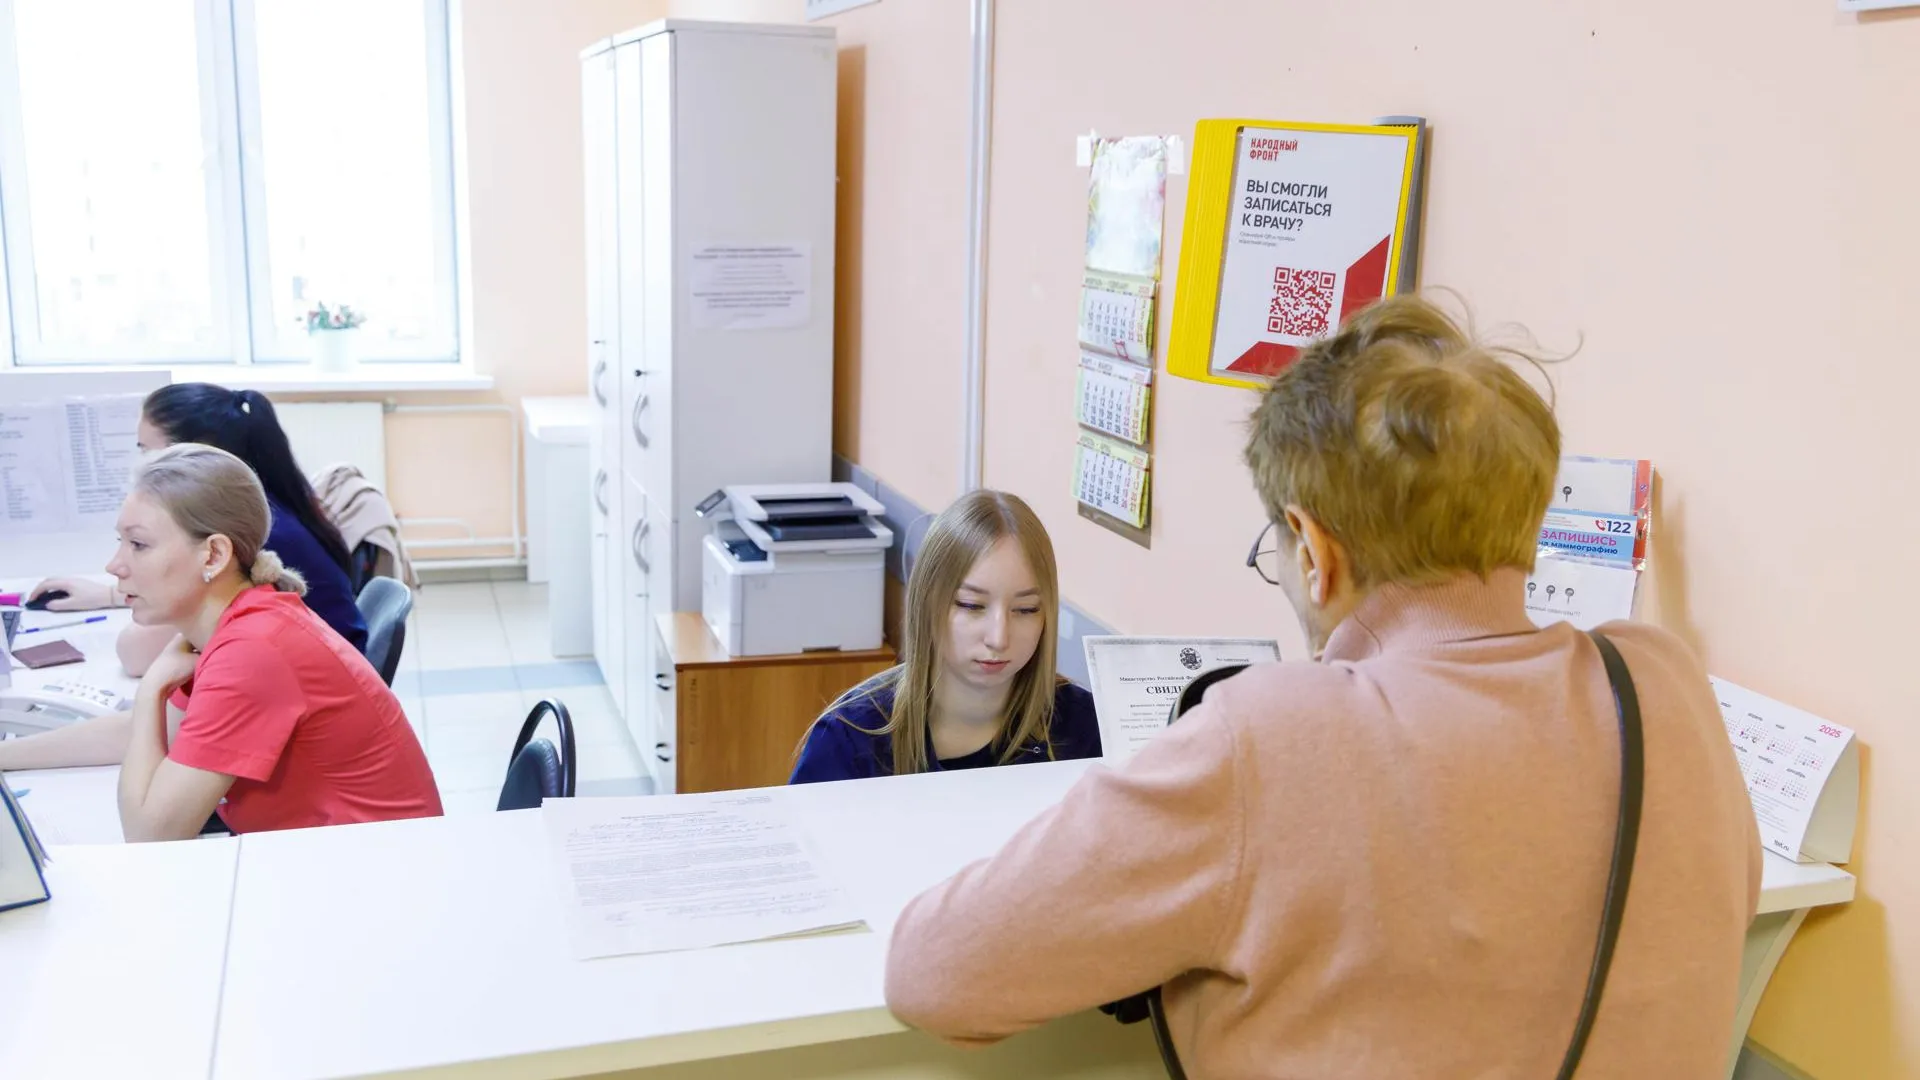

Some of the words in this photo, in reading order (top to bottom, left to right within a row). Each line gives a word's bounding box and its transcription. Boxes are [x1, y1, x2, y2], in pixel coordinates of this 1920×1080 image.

[1250, 138, 1298, 151] НАРОДНЫЙ
[1250, 150, 1279, 161] ФРОНТ
[1246, 179, 1269, 194] ВЫ
[1271, 182, 1328, 199] СМОГЛИ
[1244, 196, 1332, 217] ЗАПИСАТЬСЯ
[1242, 213, 1251, 227] К
[1254, 214, 1304, 232] ВРАЧУ?
[1606, 520, 1632, 534] 122
[1541, 529, 1617, 546] ЗАПИШИСЬ
[1551, 541, 1618, 554] маммографию
[1819, 724, 1842, 738] 2025
